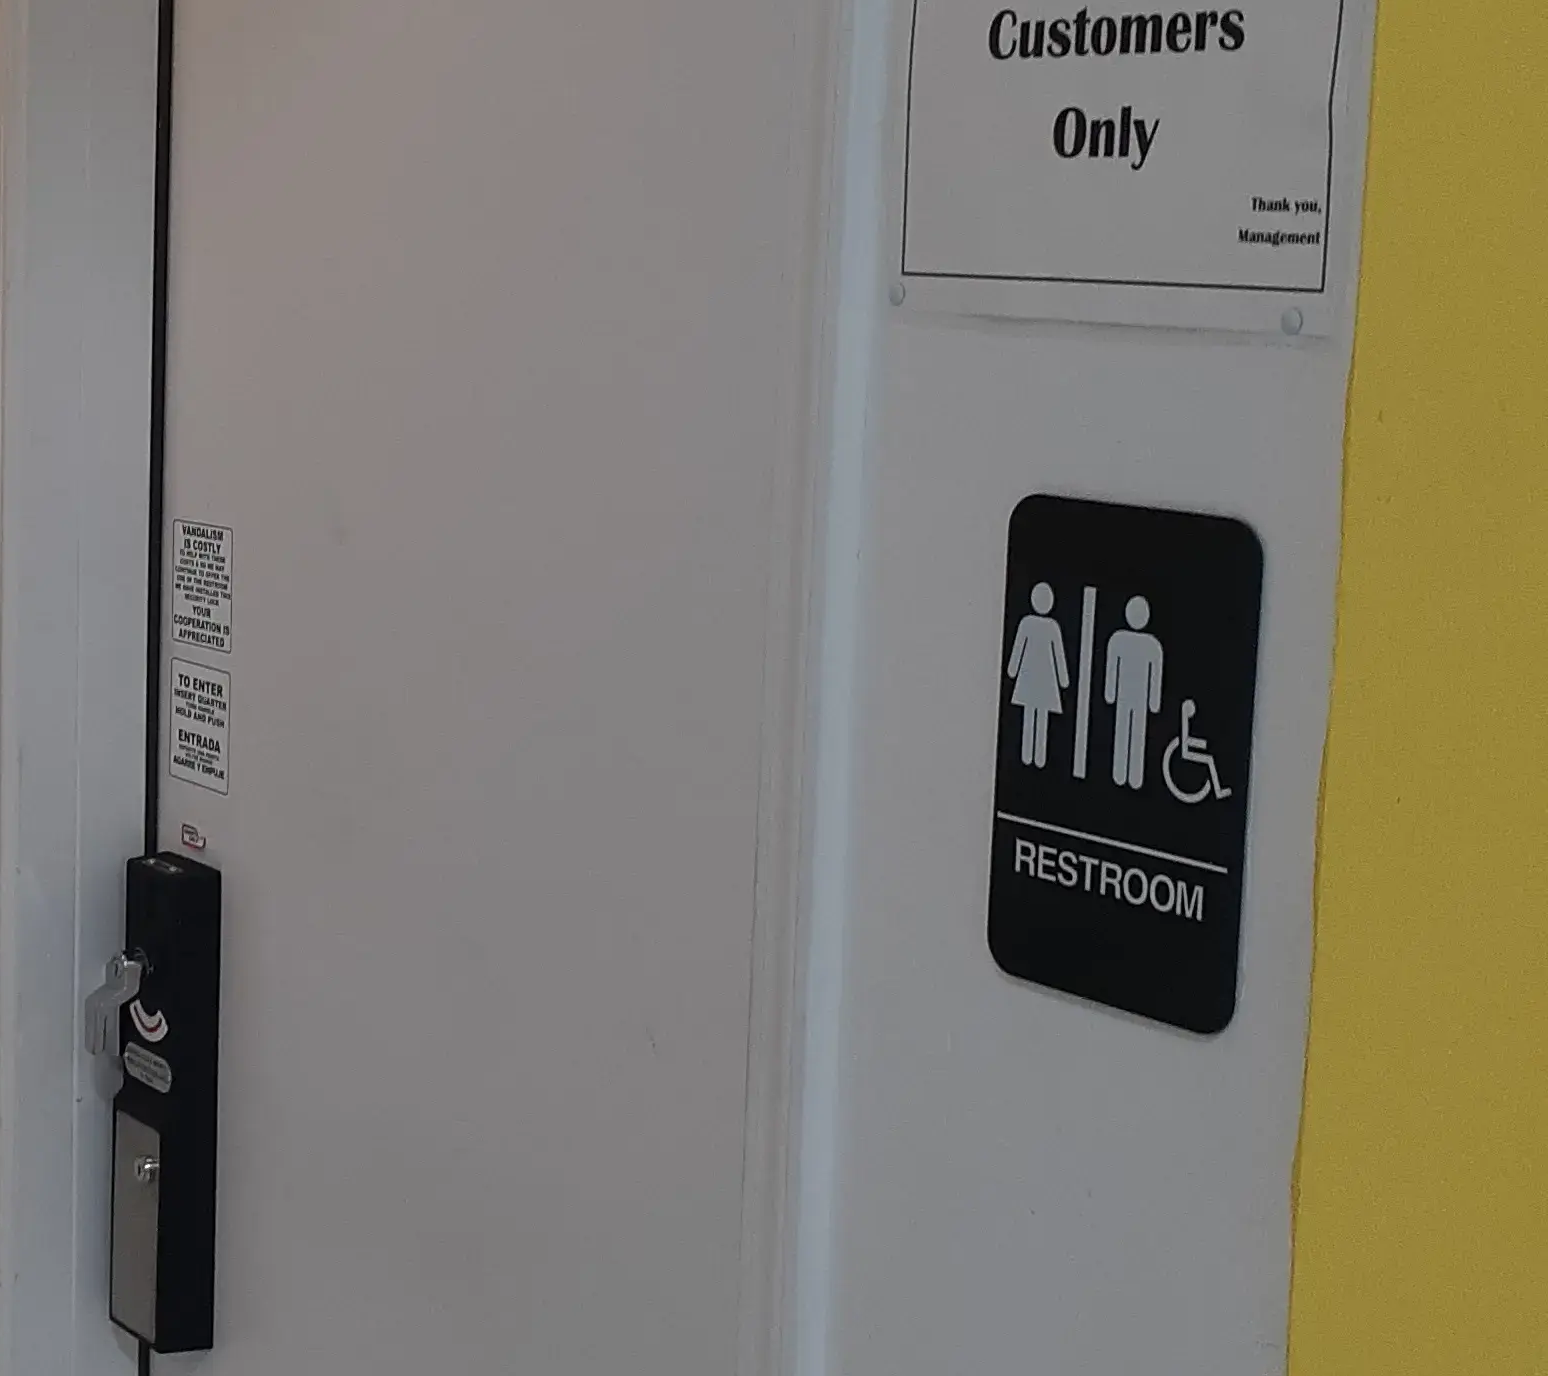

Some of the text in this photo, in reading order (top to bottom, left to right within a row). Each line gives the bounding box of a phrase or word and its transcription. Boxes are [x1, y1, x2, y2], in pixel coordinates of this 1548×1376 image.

[987, 6, 1246, 60] Customers
[1052, 104, 1161, 171] Only
[1250, 196, 1322, 215] Thank you,
[1237, 227, 1321, 247] Management
[181, 525, 224, 541] VANDALISM
[184, 538, 221, 554] IS COSTLY
[193, 604, 211, 618] YOUR
[174, 614, 230, 636] COOPERATION IS
[178, 628, 225, 648] APPRECIATED
[178, 673, 223, 697] TO ENTER
[174, 688, 227, 711] INSERT QUARTER
[175, 705, 225, 728] HOLD AND PUSH
[178, 728, 221, 754] ENTRADA
[1013, 836, 1205, 922] RESTROOM
